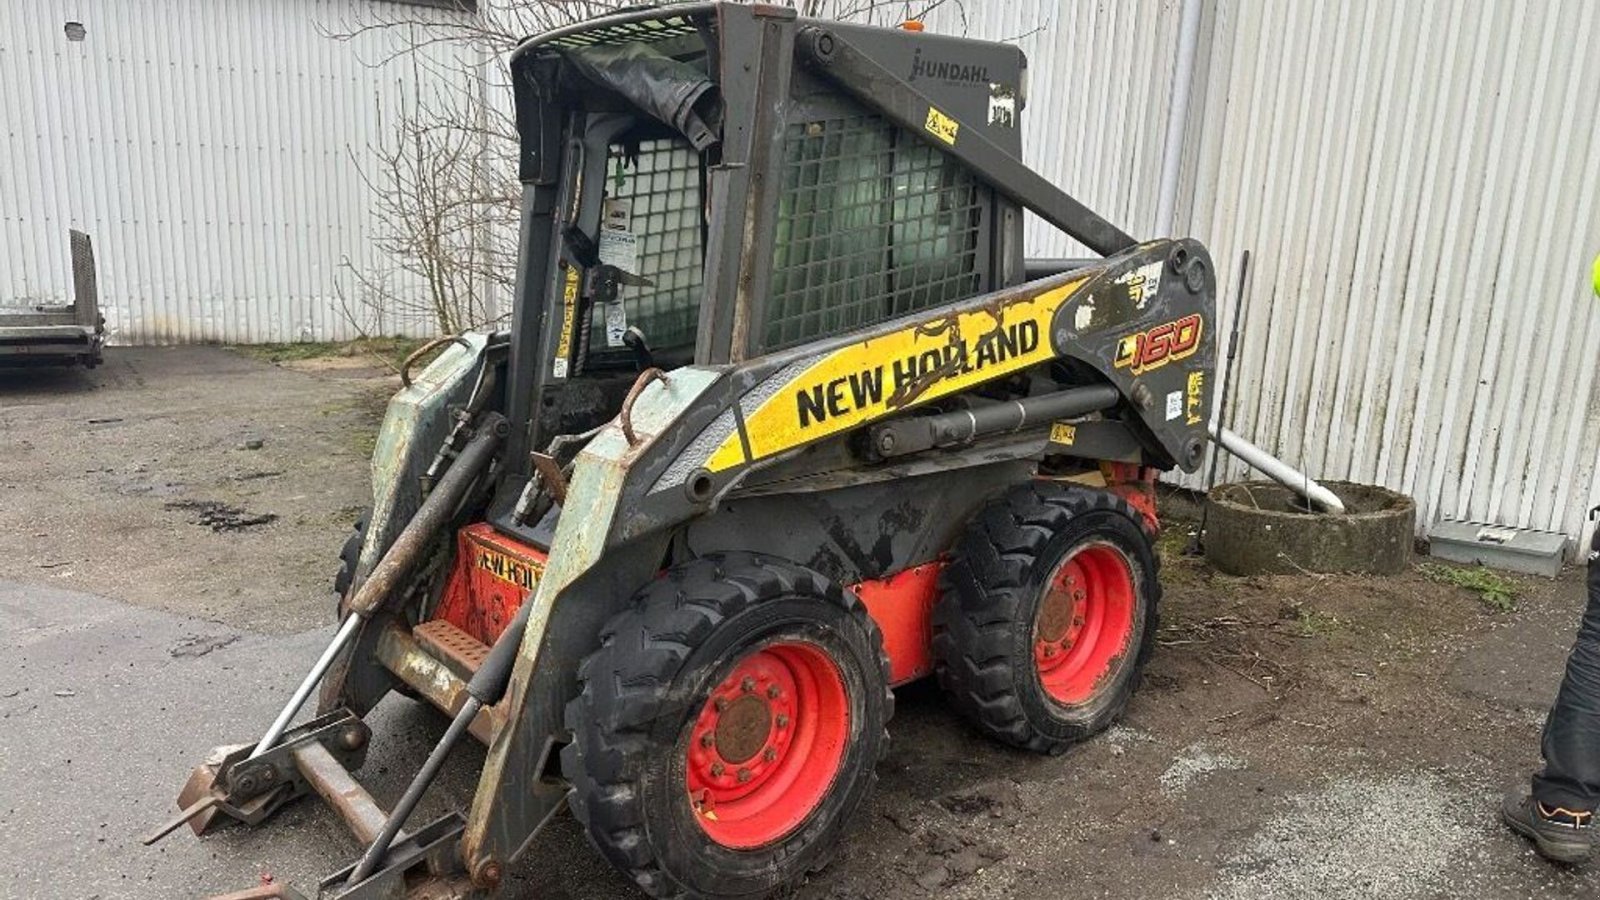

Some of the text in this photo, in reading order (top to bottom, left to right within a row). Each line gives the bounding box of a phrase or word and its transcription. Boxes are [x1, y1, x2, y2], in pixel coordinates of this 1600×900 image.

[796, 319, 1039, 428] NEW HOLLAND
[1115, 314, 1203, 372] L160
